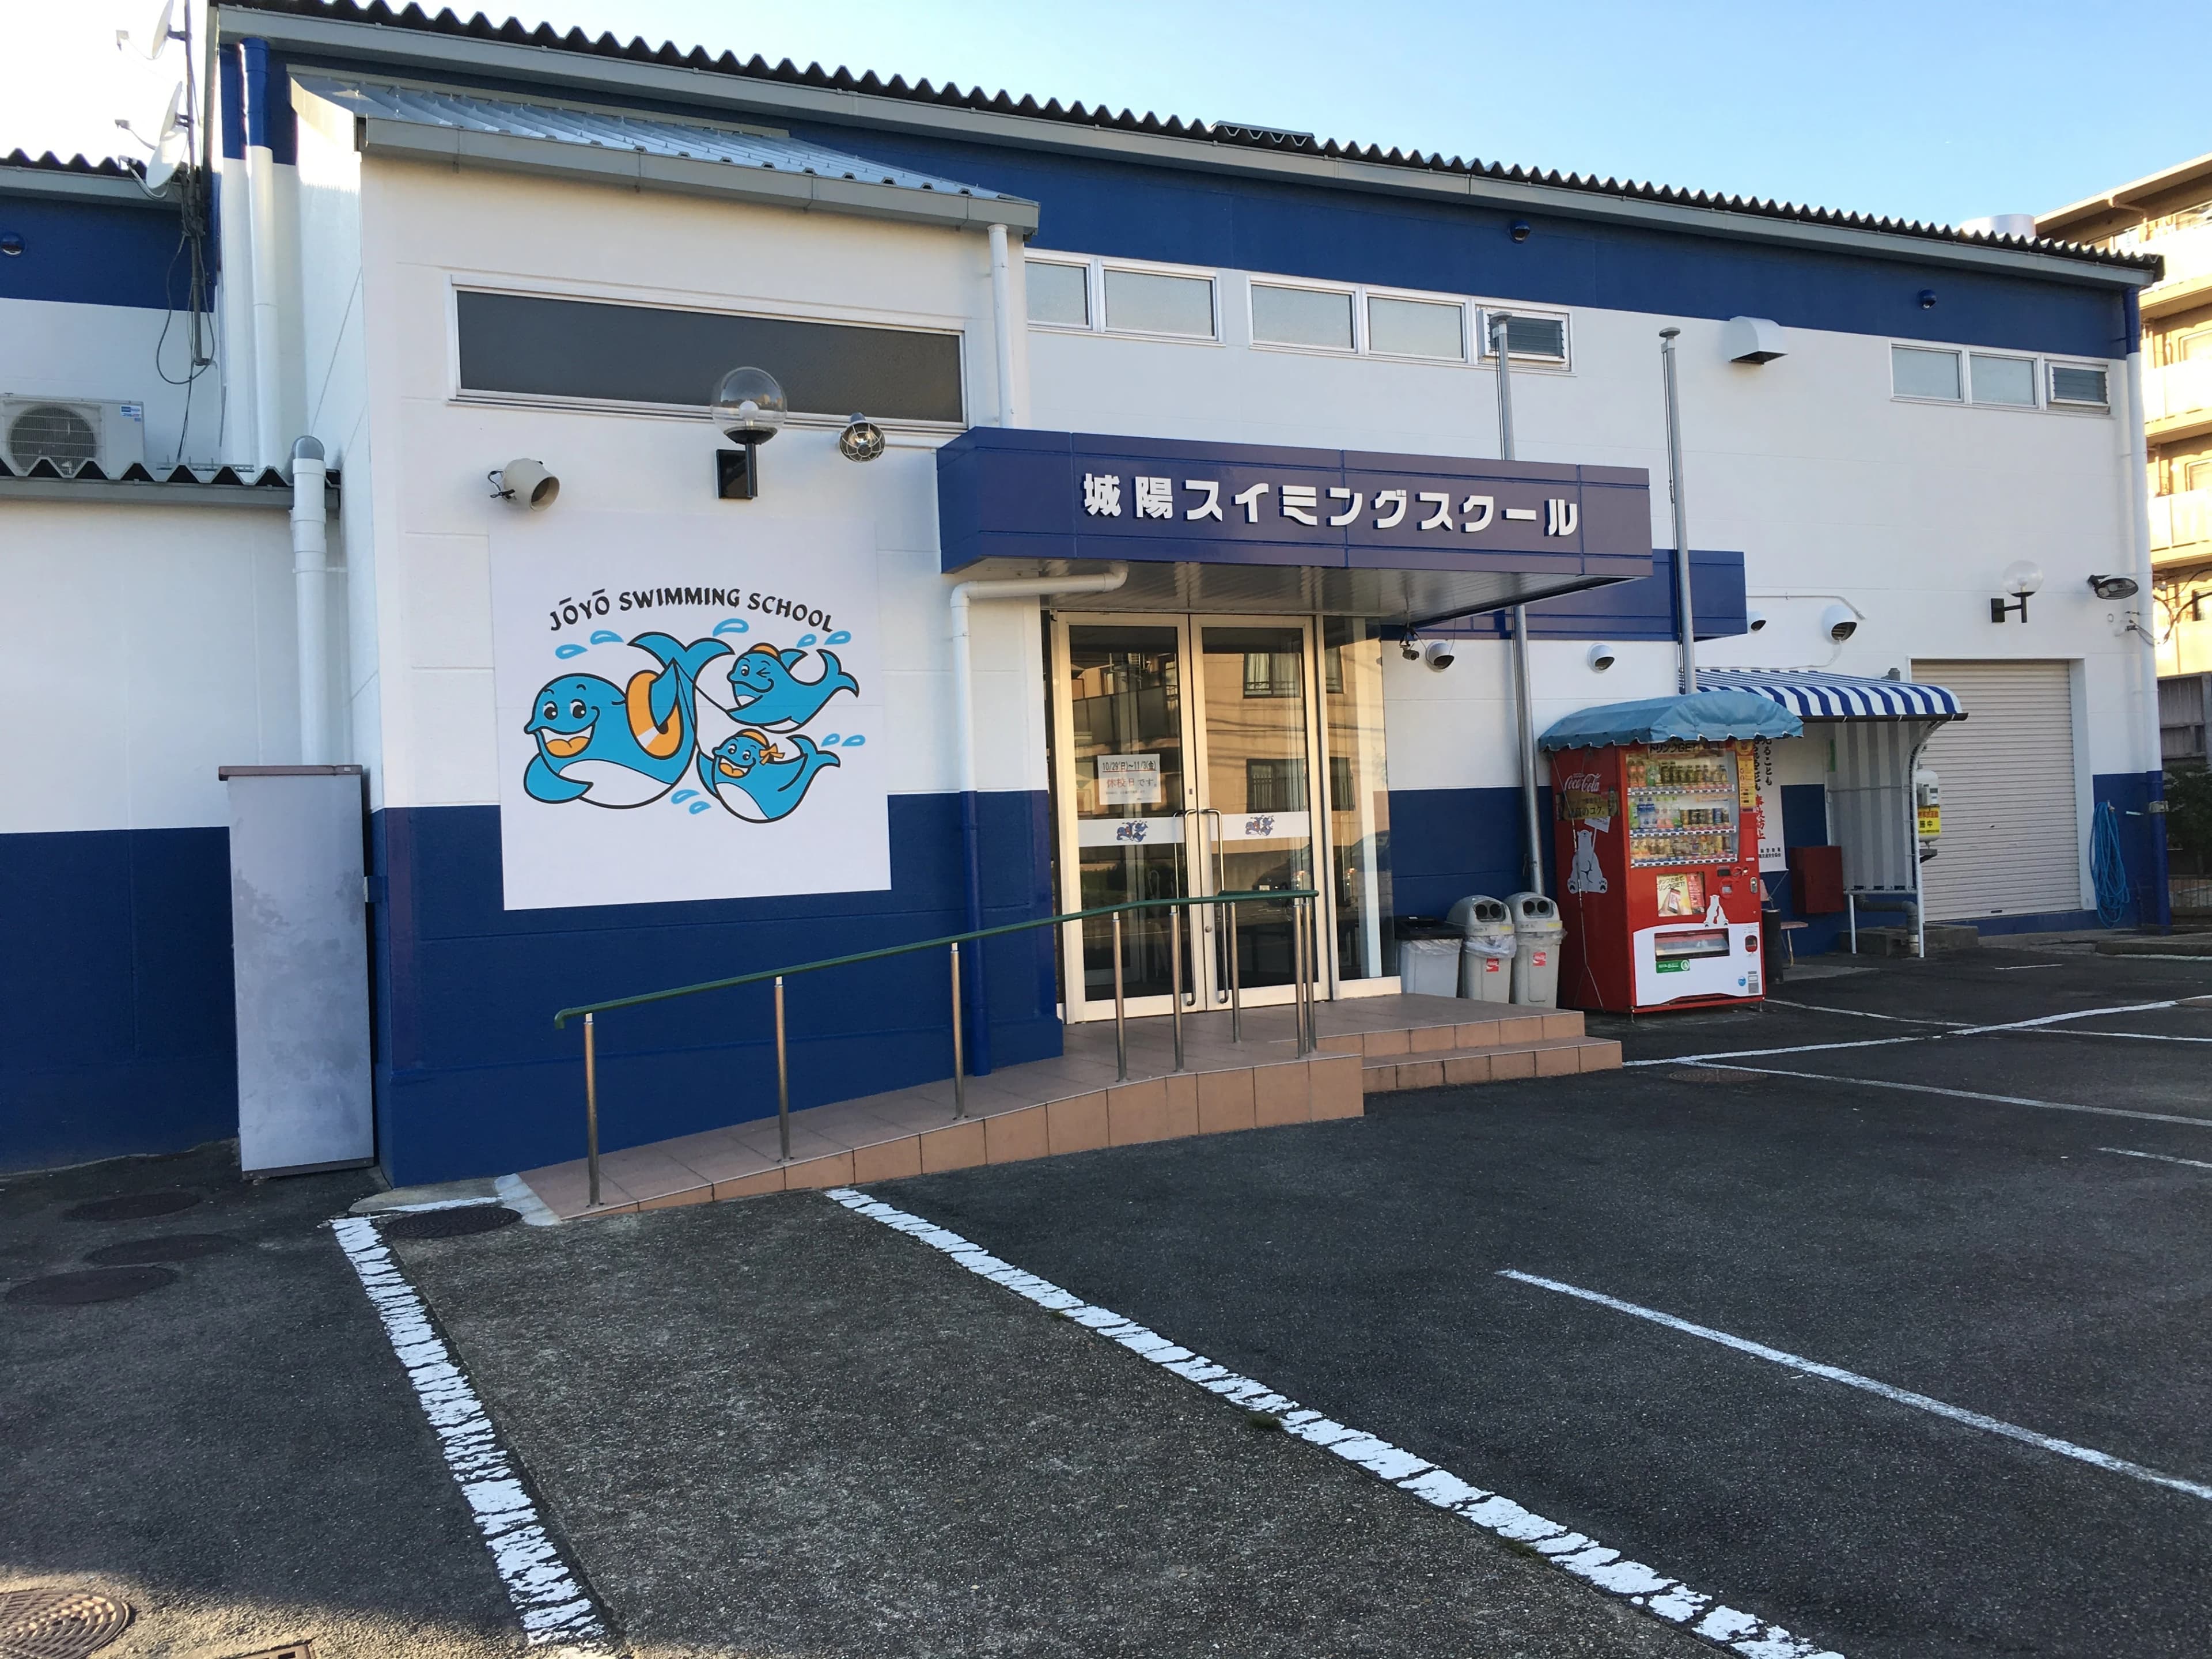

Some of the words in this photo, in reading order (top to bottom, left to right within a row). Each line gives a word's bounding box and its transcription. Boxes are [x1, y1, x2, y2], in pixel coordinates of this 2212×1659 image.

[1082, 473, 1580, 536] 城陽スイミングスクール
[619, 587, 741, 612] SWIMMING
[747, 592, 834, 633] SCHOOL
[1565, 773, 1601, 793] Coca-Cola
